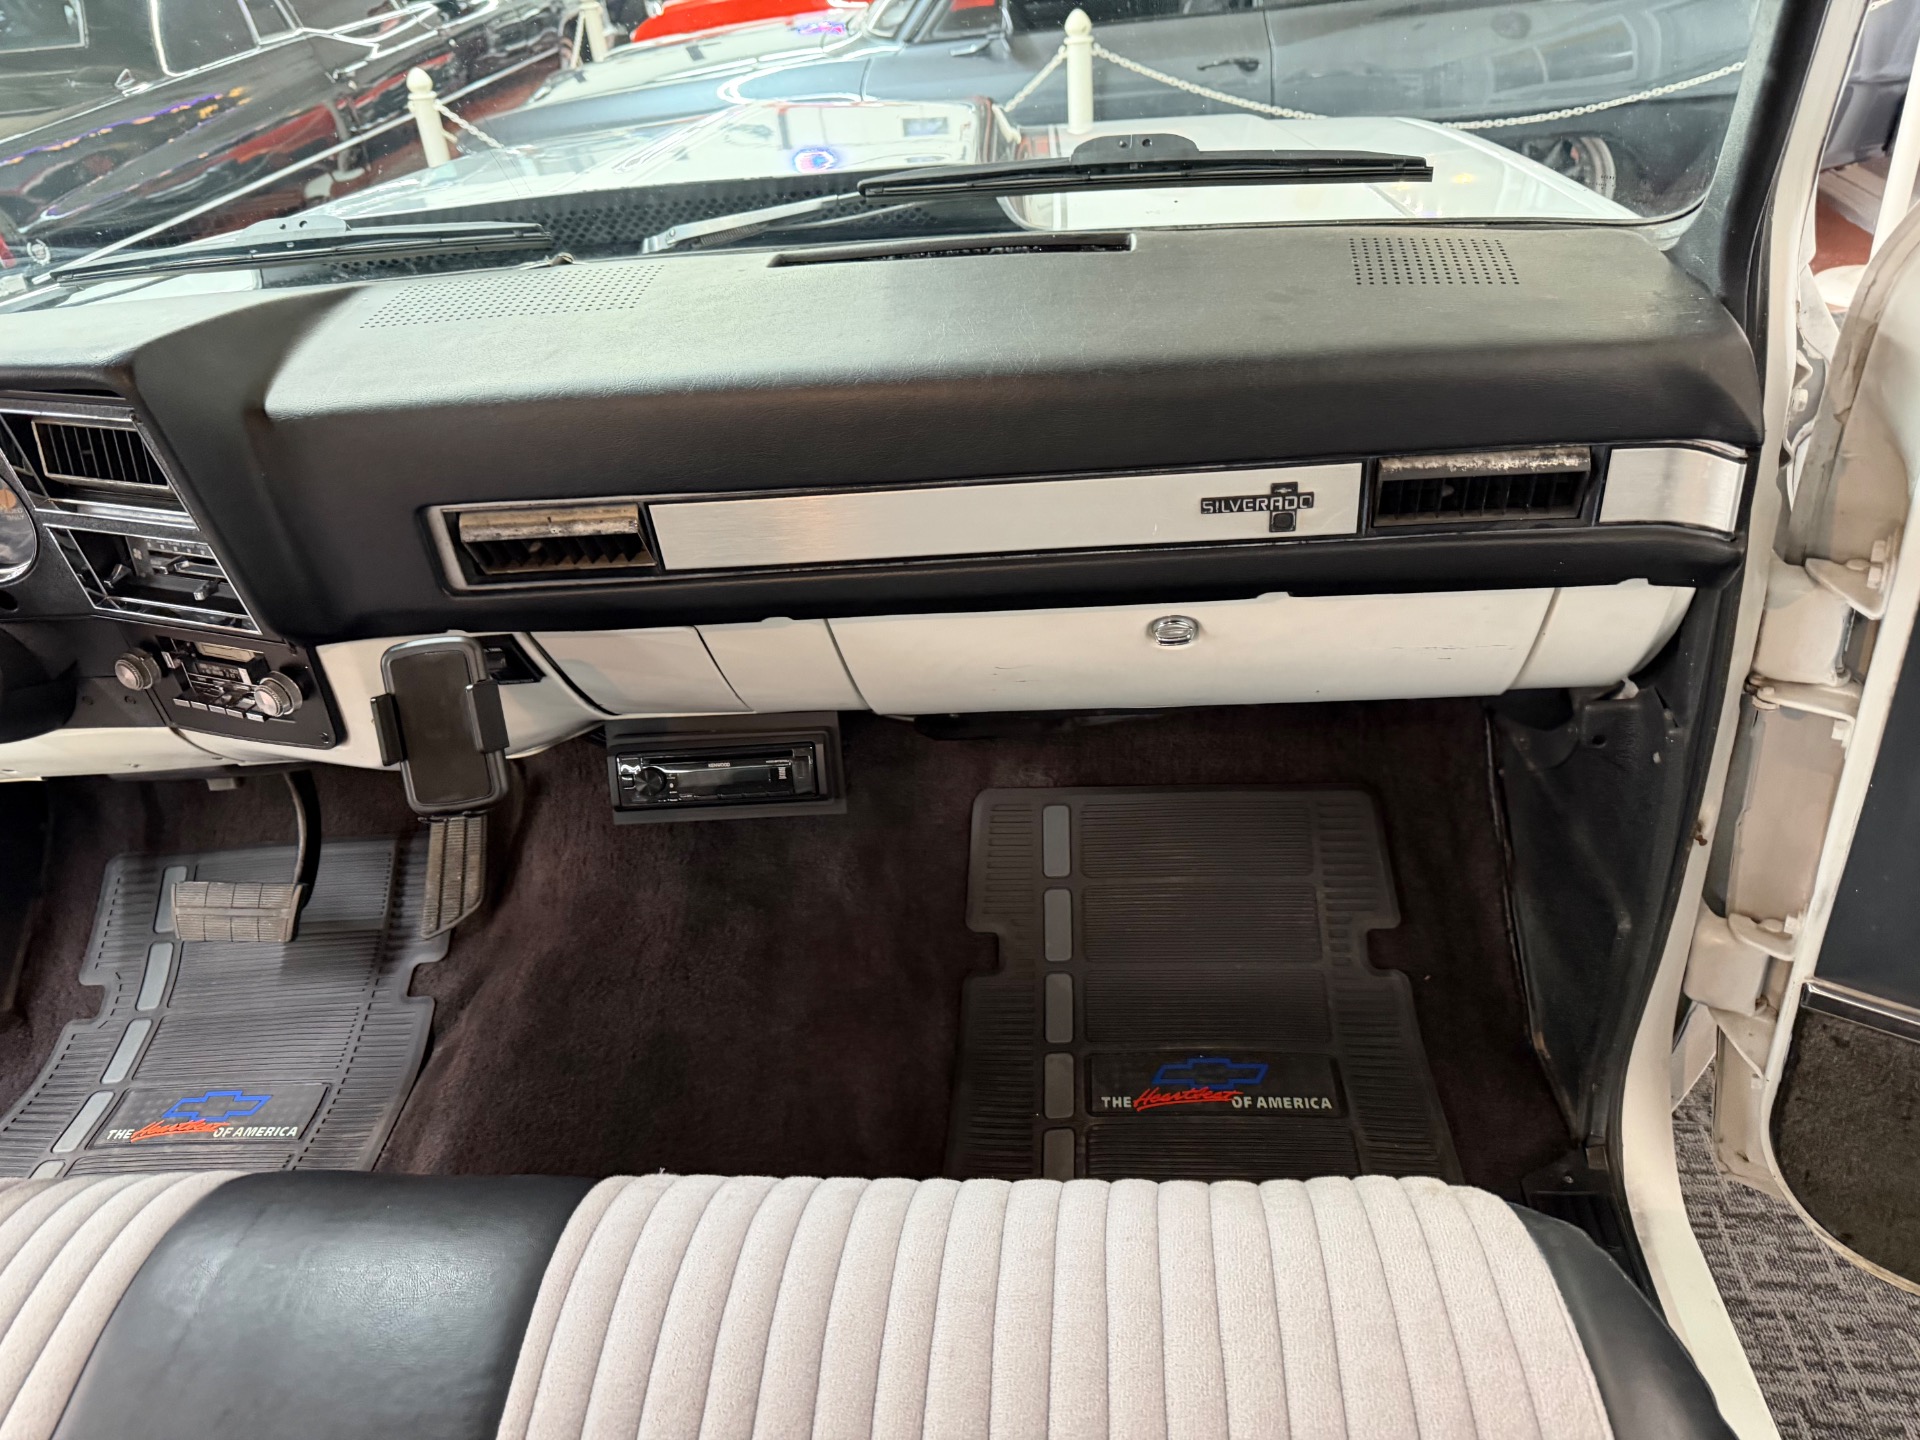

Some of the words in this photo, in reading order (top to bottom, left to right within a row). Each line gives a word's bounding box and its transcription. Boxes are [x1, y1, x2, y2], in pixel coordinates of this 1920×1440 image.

[1202, 494, 1313, 514] SILVERADO
[1101, 1096, 1132, 1108] THE
[1133, 1086, 1244, 1112] Heartbeat
[1231, 1096, 1257, 1109] OF
[1256, 1096, 1333, 1109] AMERICA
[106, 1129, 135, 1140] THE
[212, 1126, 234, 1138] OF
[232, 1126, 299, 1138] AMERICA
